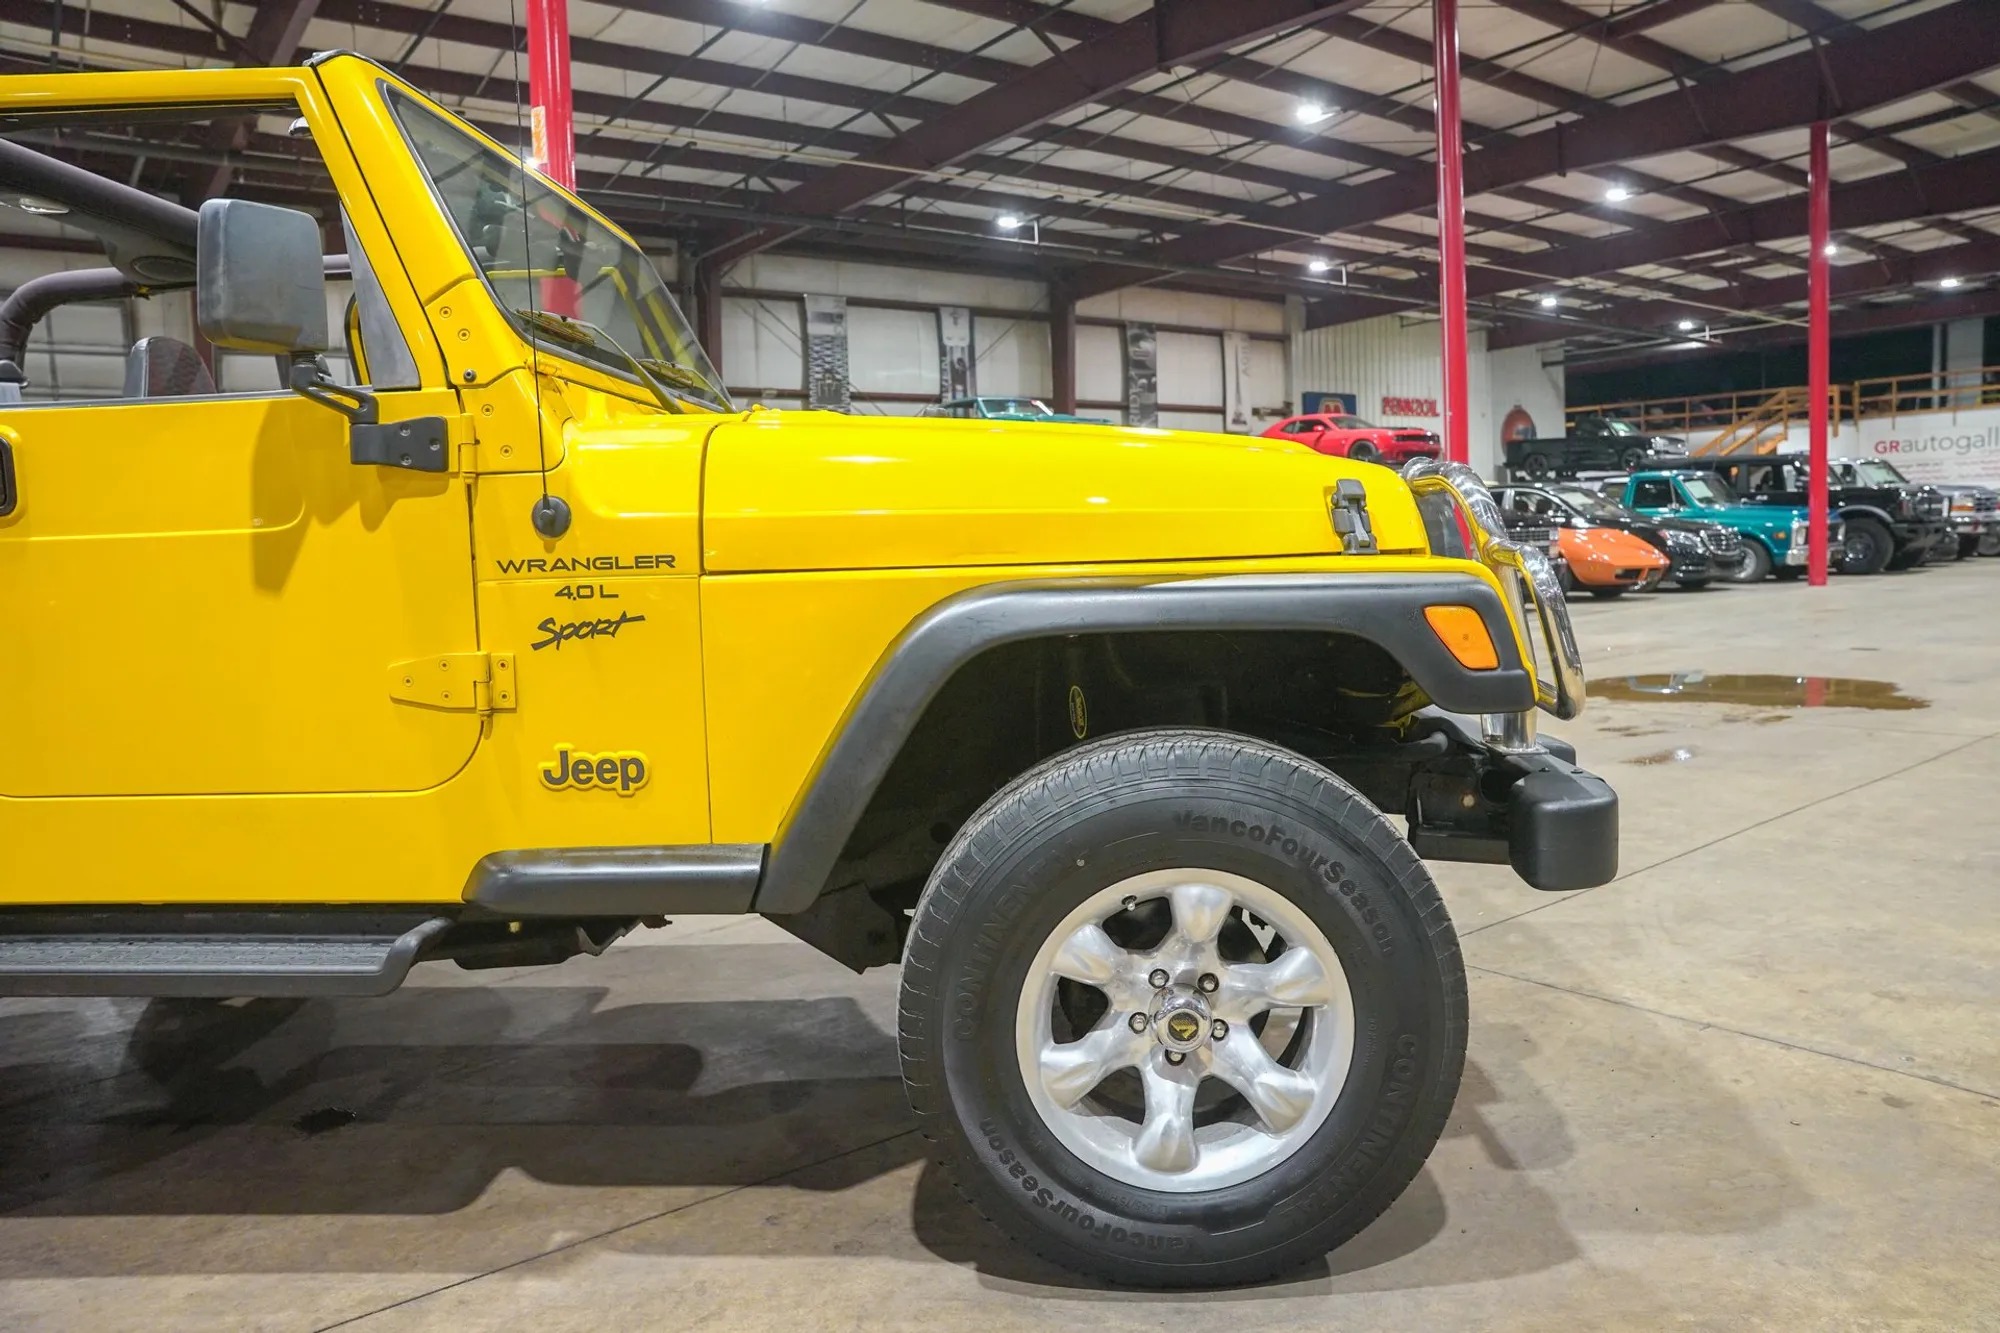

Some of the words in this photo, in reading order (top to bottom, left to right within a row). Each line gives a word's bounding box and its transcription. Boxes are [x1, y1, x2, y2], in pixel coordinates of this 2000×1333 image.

[496, 555, 676, 574] WRANGLER
[543, 750, 645, 791] Jeep
[952, 830, 1078, 1041] CONTINEN
[1174, 809, 1395, 956] VancoFourSeason
[1289, 1033, 1418, 1228] CONTINENTA
